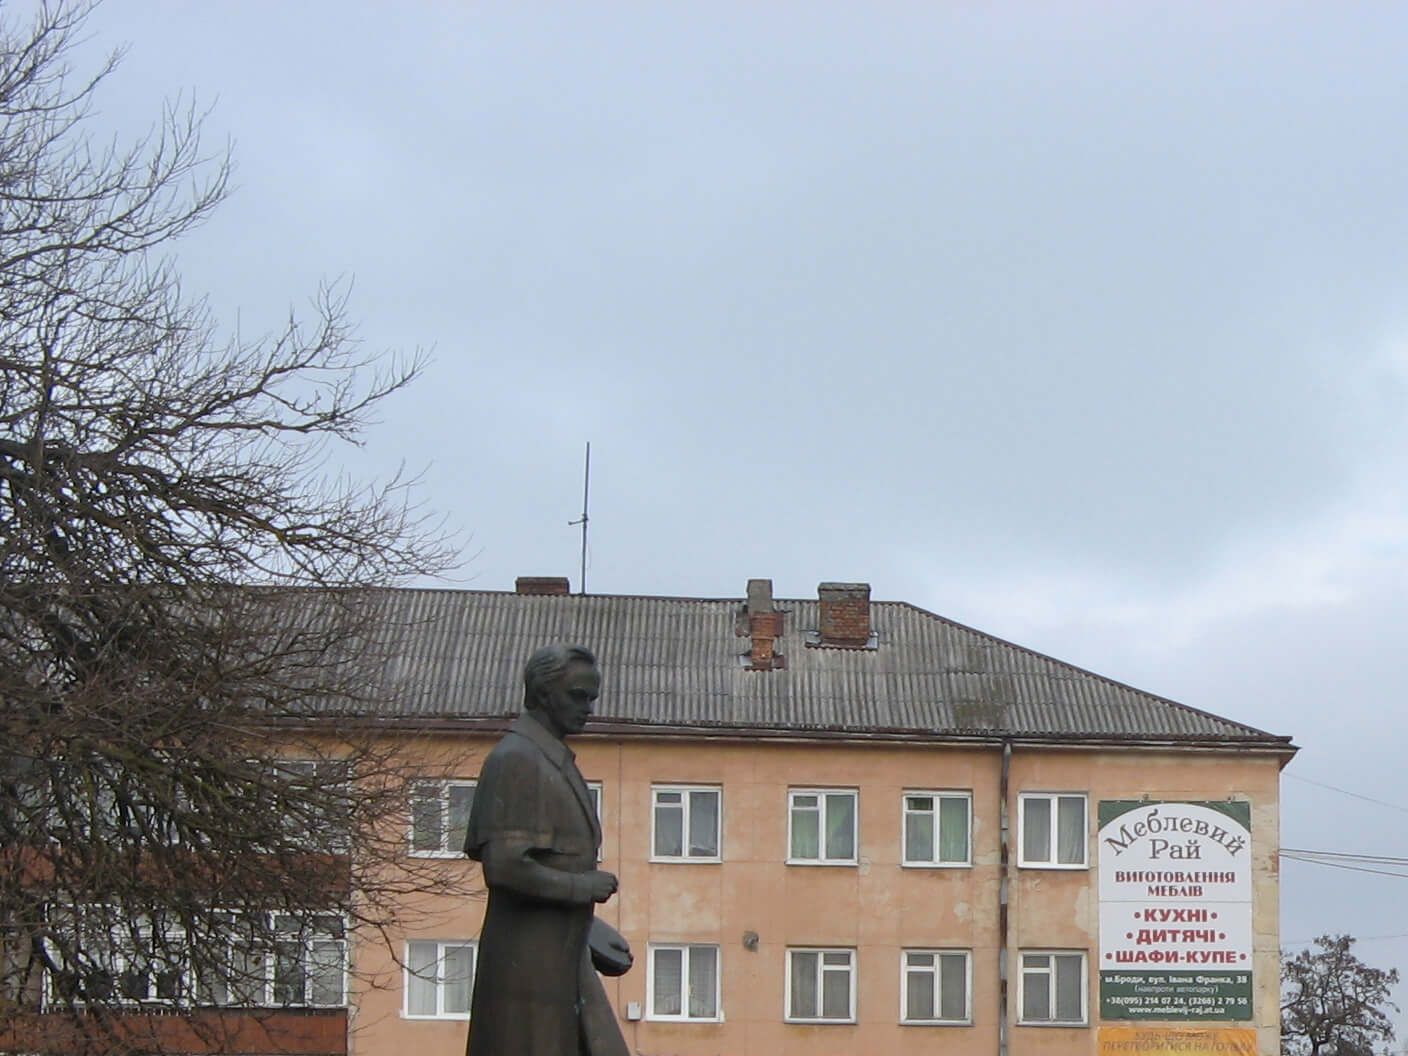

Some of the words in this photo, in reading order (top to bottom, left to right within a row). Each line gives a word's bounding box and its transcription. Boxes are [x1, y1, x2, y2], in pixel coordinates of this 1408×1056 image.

[1104, 808, 1246, 857] Меблевий
[1149, 838, 1202, 860] Рай
[1115, 870, 1236, 883] ВИГОТОВЛЕННЯ
[1147, 885, 1204, 897] МЕБЛІВ
[1144, 908, 1208, 923] КУХНІ
[1136, 929, 1216, 945] ДИТЯЧІ
[1115, 950, 1237, 964] ШАФИ-КУПЕ
